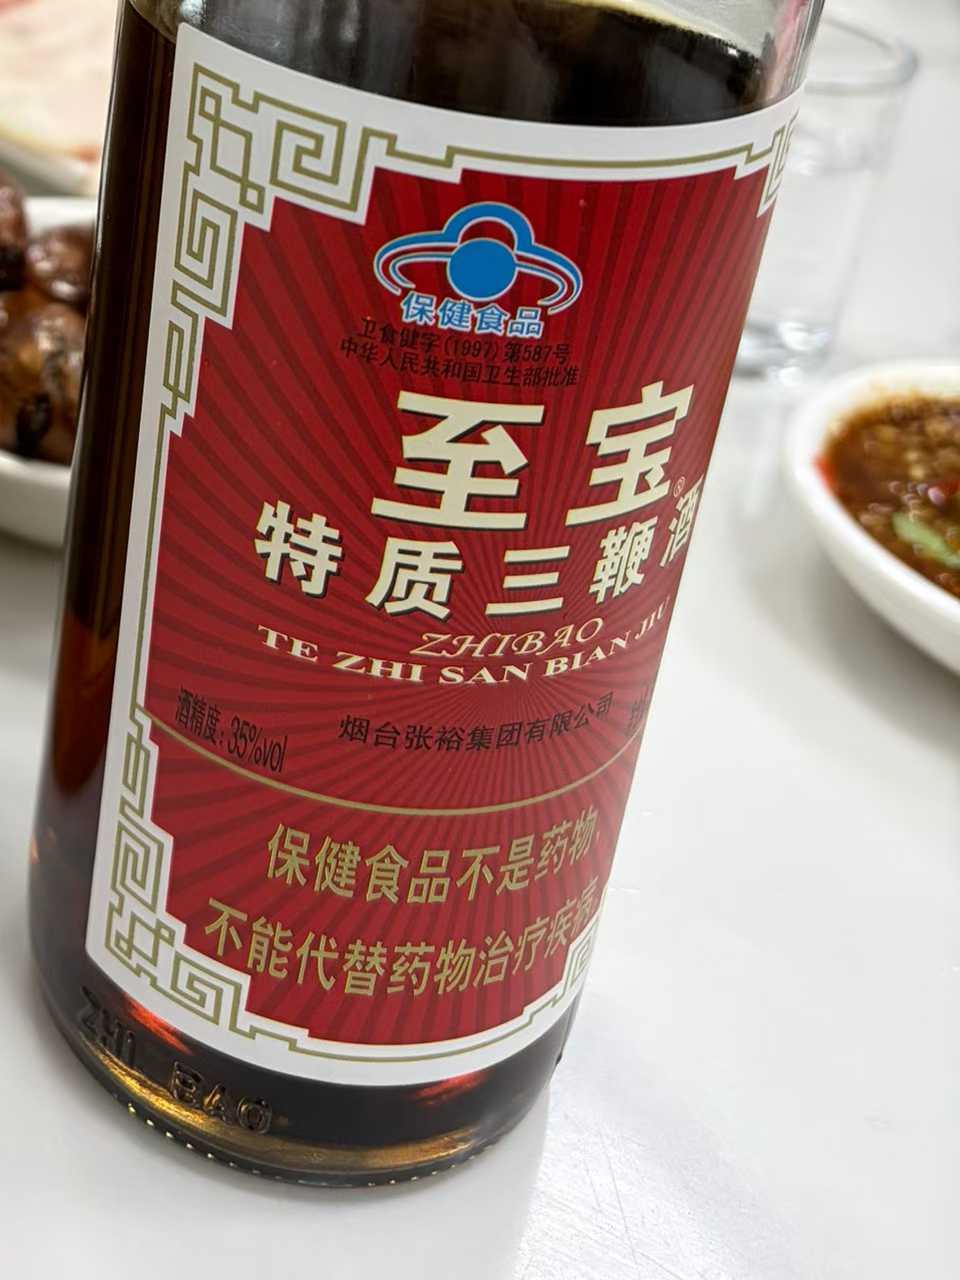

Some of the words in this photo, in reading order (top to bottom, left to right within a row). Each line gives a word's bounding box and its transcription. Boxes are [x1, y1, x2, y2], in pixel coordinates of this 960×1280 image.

[400, 291, 545, 338] 保健食品
[340, 337, 580, 387] 中华人民共和国卫生部批准
[371, 380, 695, 531] 至宝
[253, 475, 704, 622] 特质三鞭酒
[257, 624, 320, 664] TE
[332, 651, 427, 683] ZHI
[439, 662, 534, 685] SAN
[543, 630, 632, 677] BIAN
[409, 617, 604, 658] ZHIBAO
[338, 690, 614, 753] 烟台张裕集团有限公司
[204, 875, 599, 998] 不能代替药物治疗疾病
